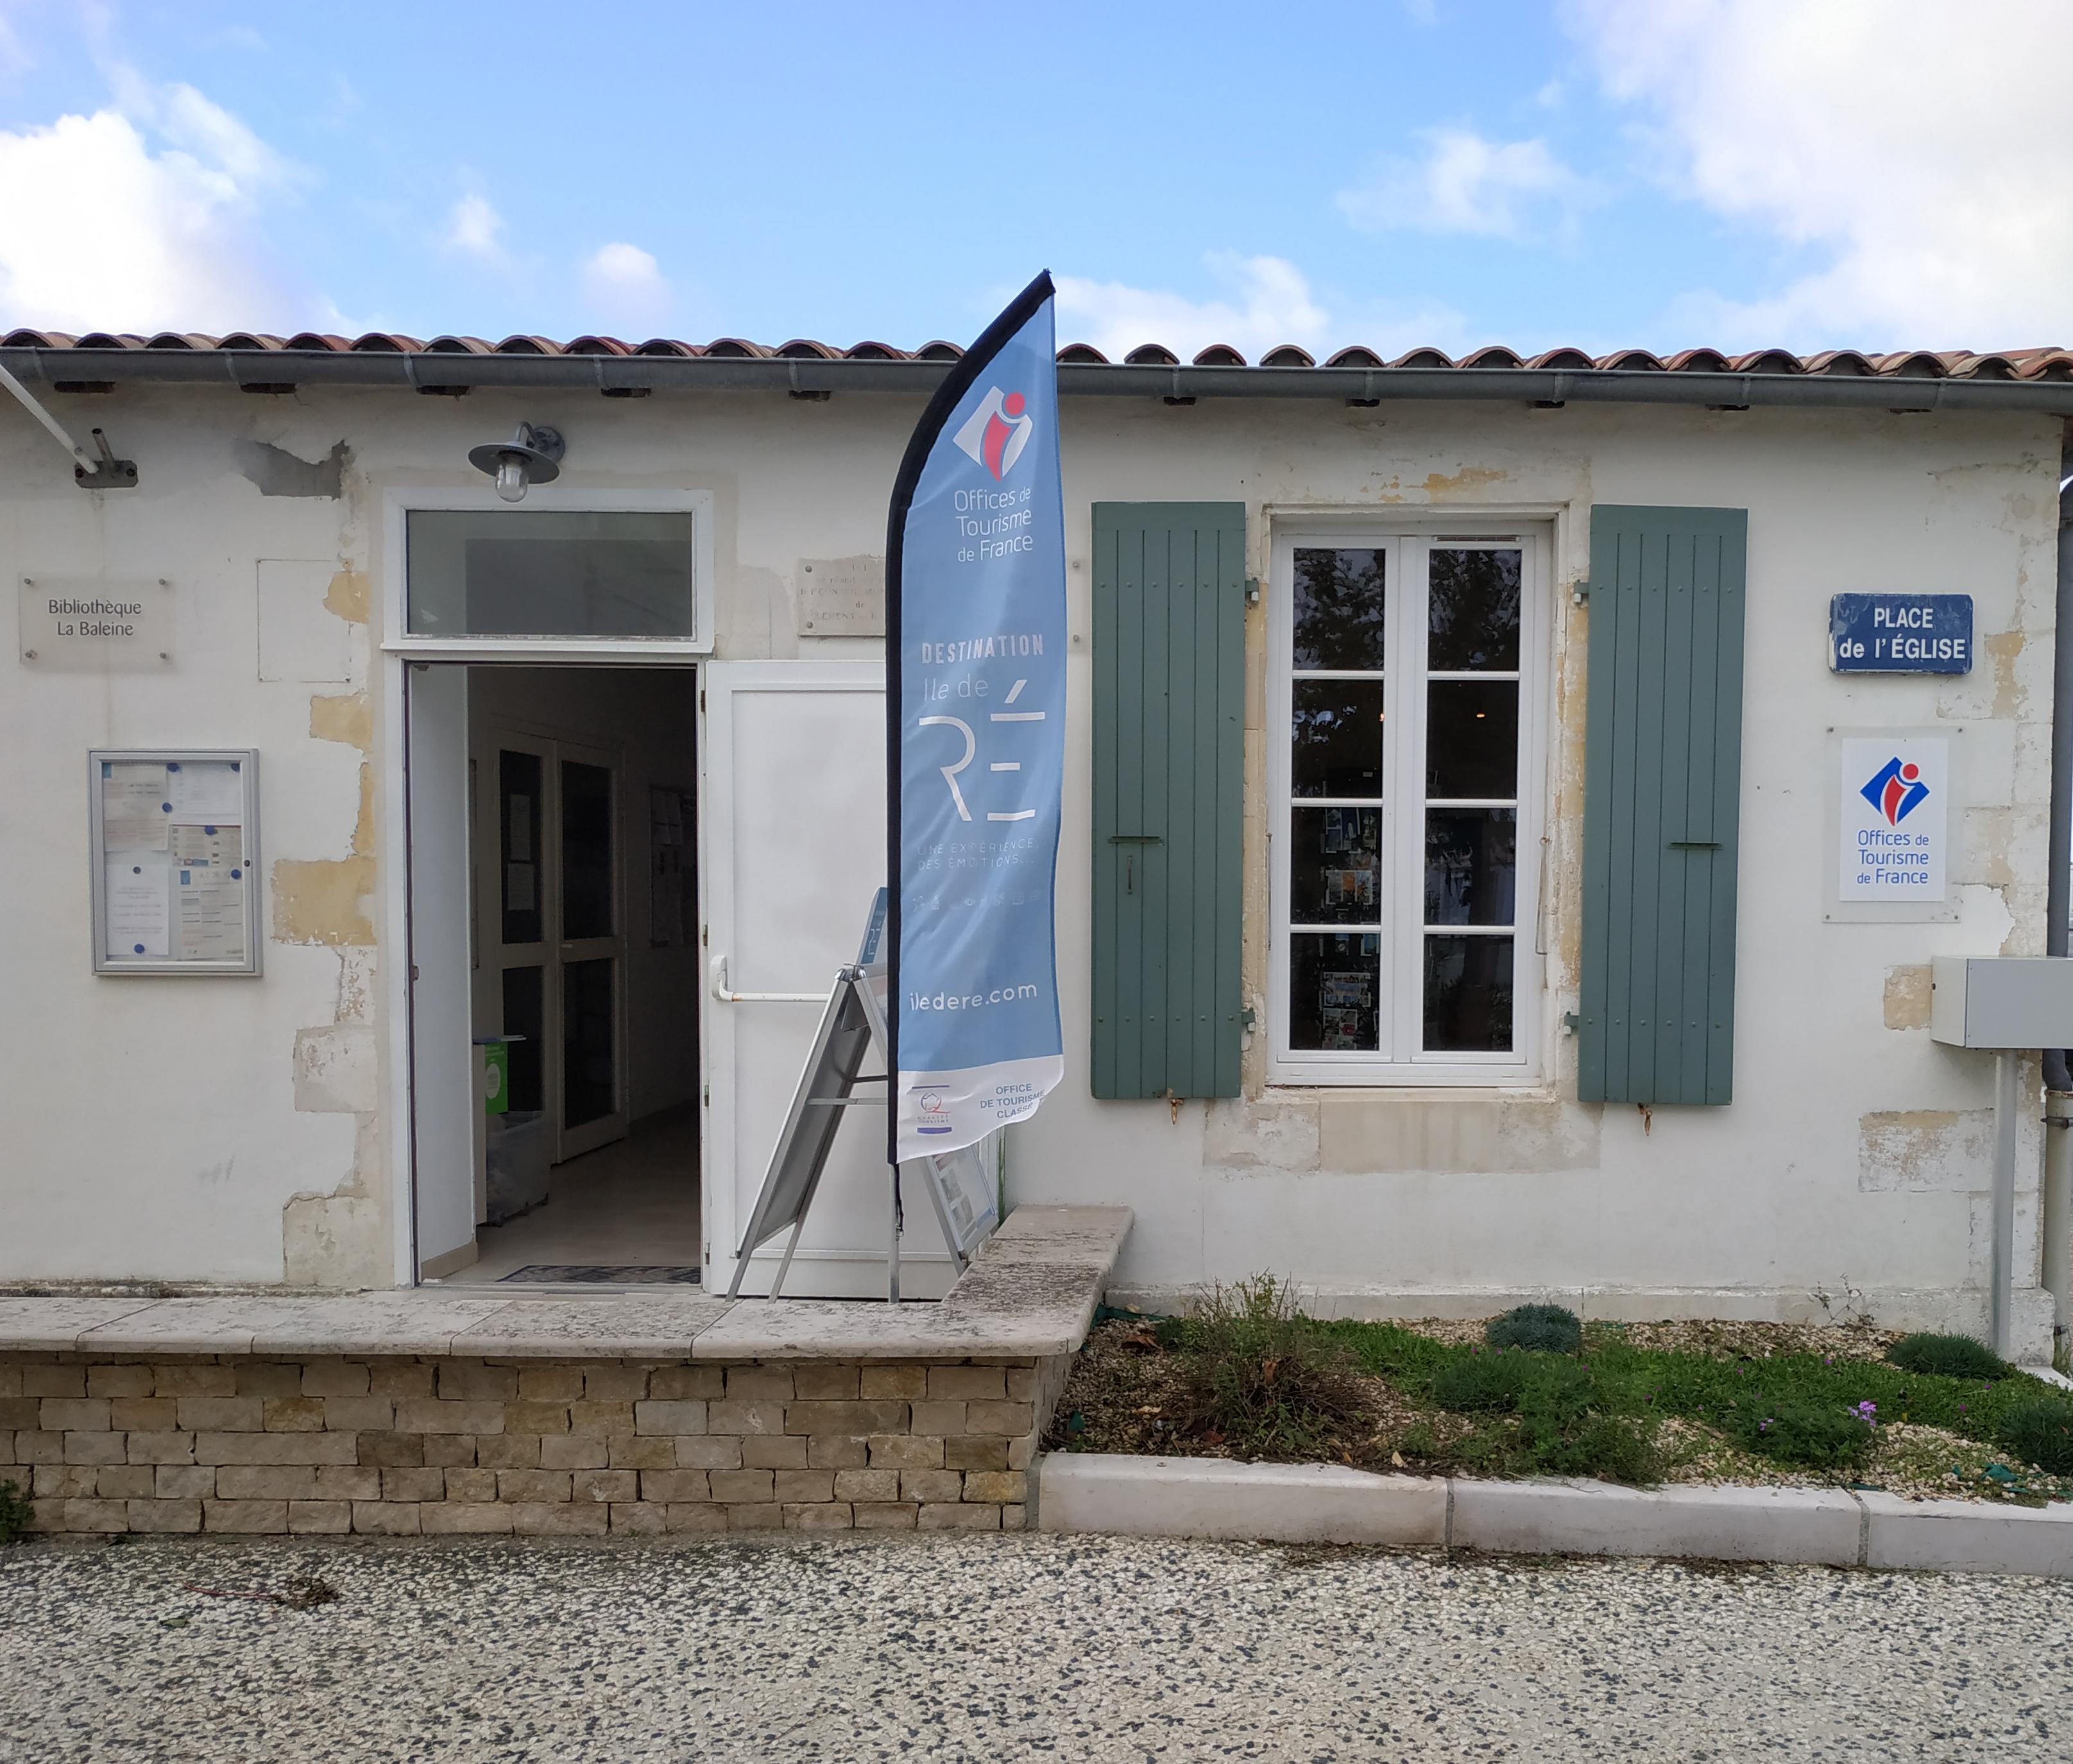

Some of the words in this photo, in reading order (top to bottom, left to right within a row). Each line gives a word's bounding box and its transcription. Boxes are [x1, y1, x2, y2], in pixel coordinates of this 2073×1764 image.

[954, 489, 1016, 512] Offices
[1019, 486, 1032, 503] de
[955, 509, 1032, 537] Tourisme
[957, 547, 975, 563] de
[980, 535, 1034, 561] France
[48, 598, 142, 618] Bibliothèque
[1873, 607, 1934, 629] PLACE
[57, 621, 74, 636] La
[80, 621, 134, 636] Baleine
[921, 634, 1044, 665] DESTINATION
[1839, 638, 1865, 659] de
[957, 672, 989, 698] de
[918, 679, 1046, 822] RÉ
[1857, 829, 1911, 846] Offices
[1915, 834, 1929, 846] de
[918, 858, 941, 870] DES
[1857, 849, 1929, 865] Tourisme
[1856, 872, 1872, 885] de
[1875, 868, 1929, 885] France
[909, 983, 1037, 1011] iledere.com
[980, 1099, 994, 1109] DE
[996, 1089, 1045, 1107] TOURISME
[995, 1083, 1032, 1095] OFFICE
